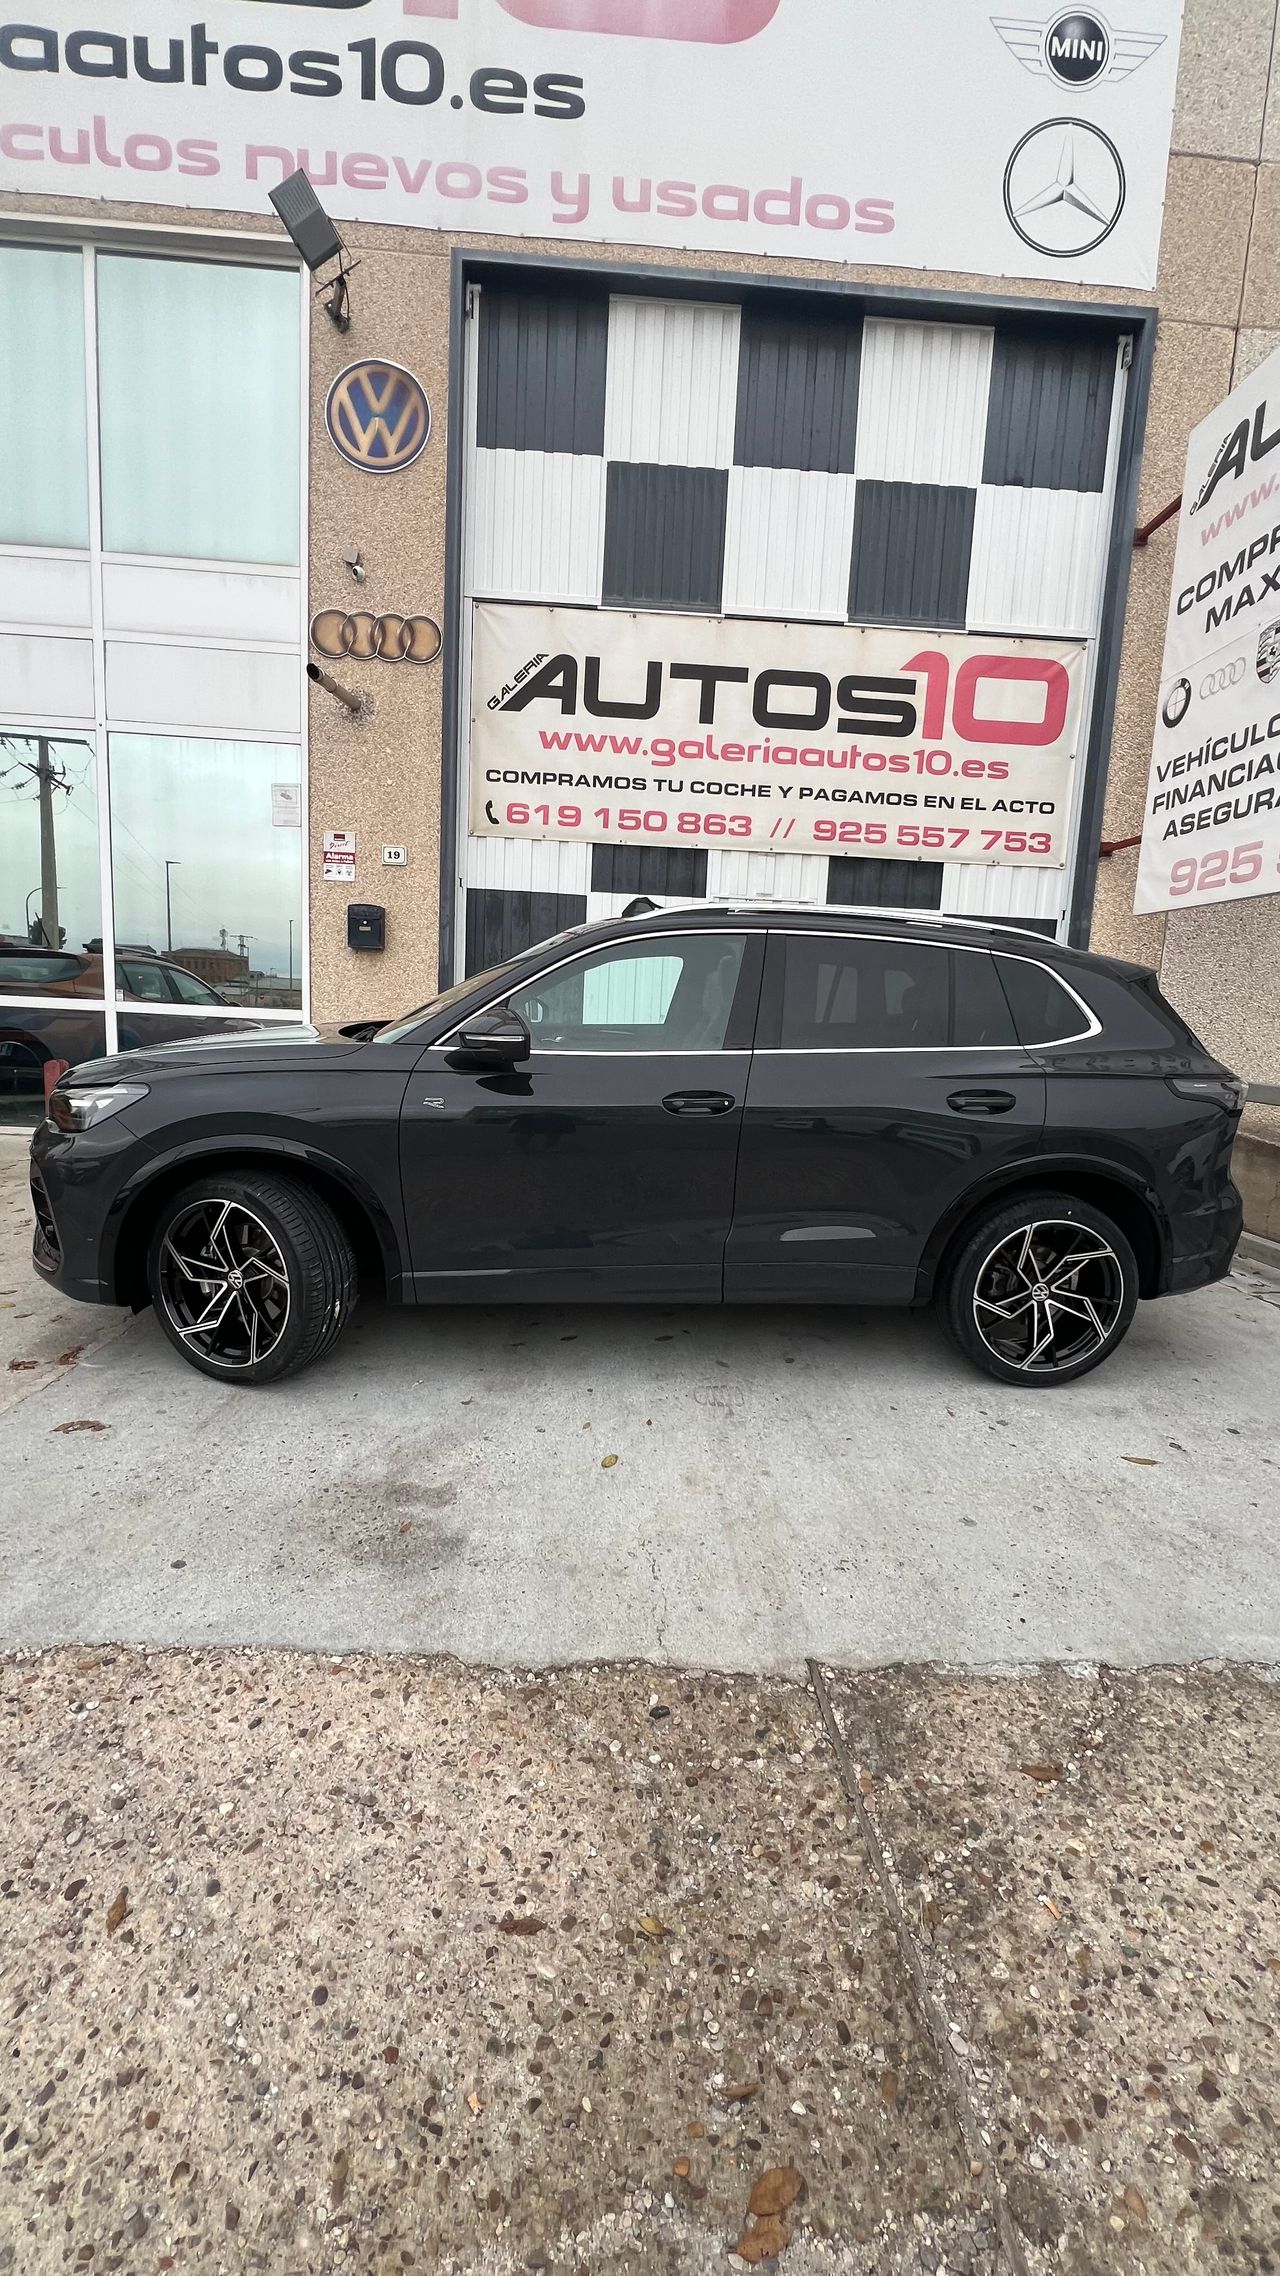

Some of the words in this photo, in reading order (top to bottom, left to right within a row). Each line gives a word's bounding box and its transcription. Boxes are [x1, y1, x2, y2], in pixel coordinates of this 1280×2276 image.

[0, 22, 586, 120] aautos10.es
[1051, 36, 1103, 61] MINI
[0, 114, 220, 176] culos
[245, 143, 529, 204] nuevos
[552, 171, 590, 224] y
[611, 175, 896, 234] usados
[487, 653, 549, 710] GALERIA
[498, 651, 1070, 747] AUTOS10
[538, 727, 1010, 780] www.galeriaautos10.es
[485, 768, 647, 792] COMPRAMOS
[653, 778, 684, 793] TU
[690, 781, 772, 799] COCHE
[778, 785, 794, 799] Y
[799, 787, 918, 808] PAGAMOS
[923, 795, 955, 810] EN
[960, 797, 987, 811] EL
[991, 799, 1056, 815] ACTO
[1152, 751, 1280, 815] FINANCIA
[505, 802, 582, 828] 619
[594, 807, 668, 833] 150
[676, 811, 753, 838] 863
[813, 819, 888, 846] 925
[896, 825, 970, 849] 557
[980, 830, 1052, 855] 753
[1162, 786, 1280, 841] ASEGUR
[325, 852, 354, 860] Alarma
[387, 850, 401, 860] 19
[1169, 840, 1264, 896] 925
